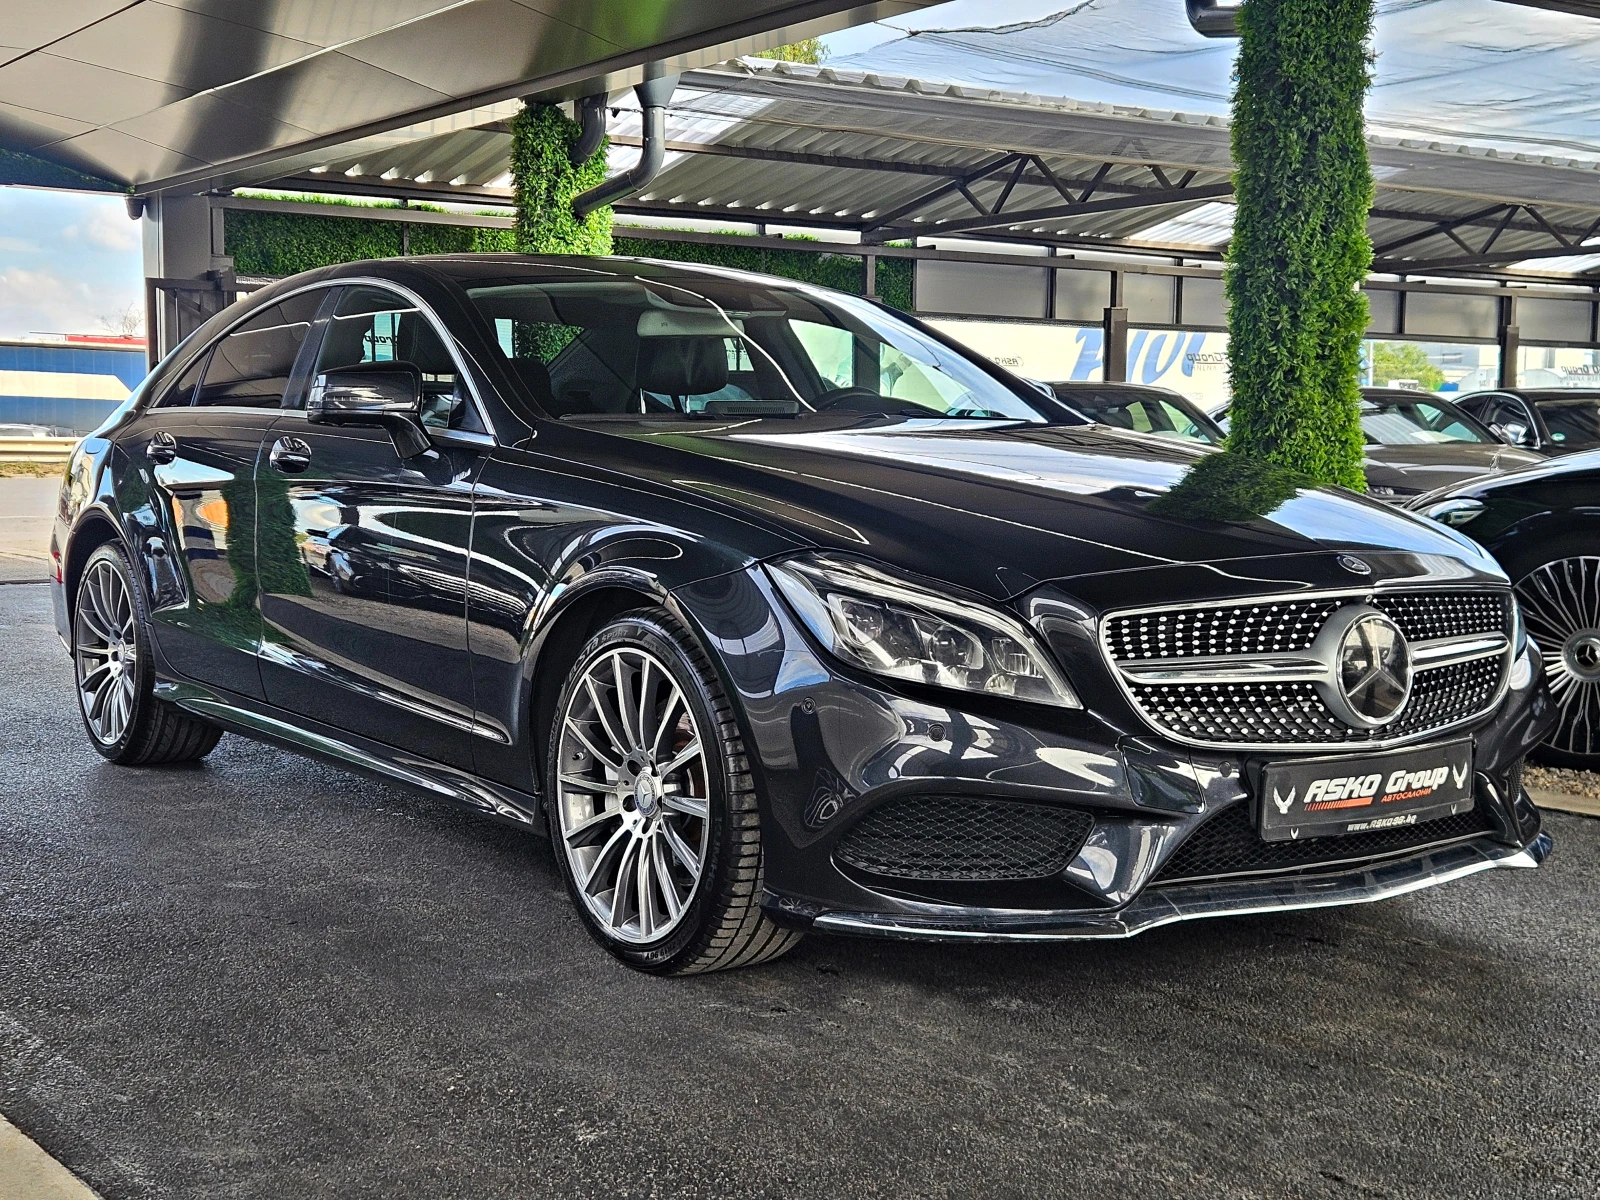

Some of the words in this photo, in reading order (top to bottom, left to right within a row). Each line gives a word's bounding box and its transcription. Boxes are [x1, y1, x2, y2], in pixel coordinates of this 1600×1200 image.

[1303, 773, 1382, 804] ASKO
[1385, 766, 1449, 792] Group
[1381, 787, 1432, 803] АВТОСАЛОНИ
